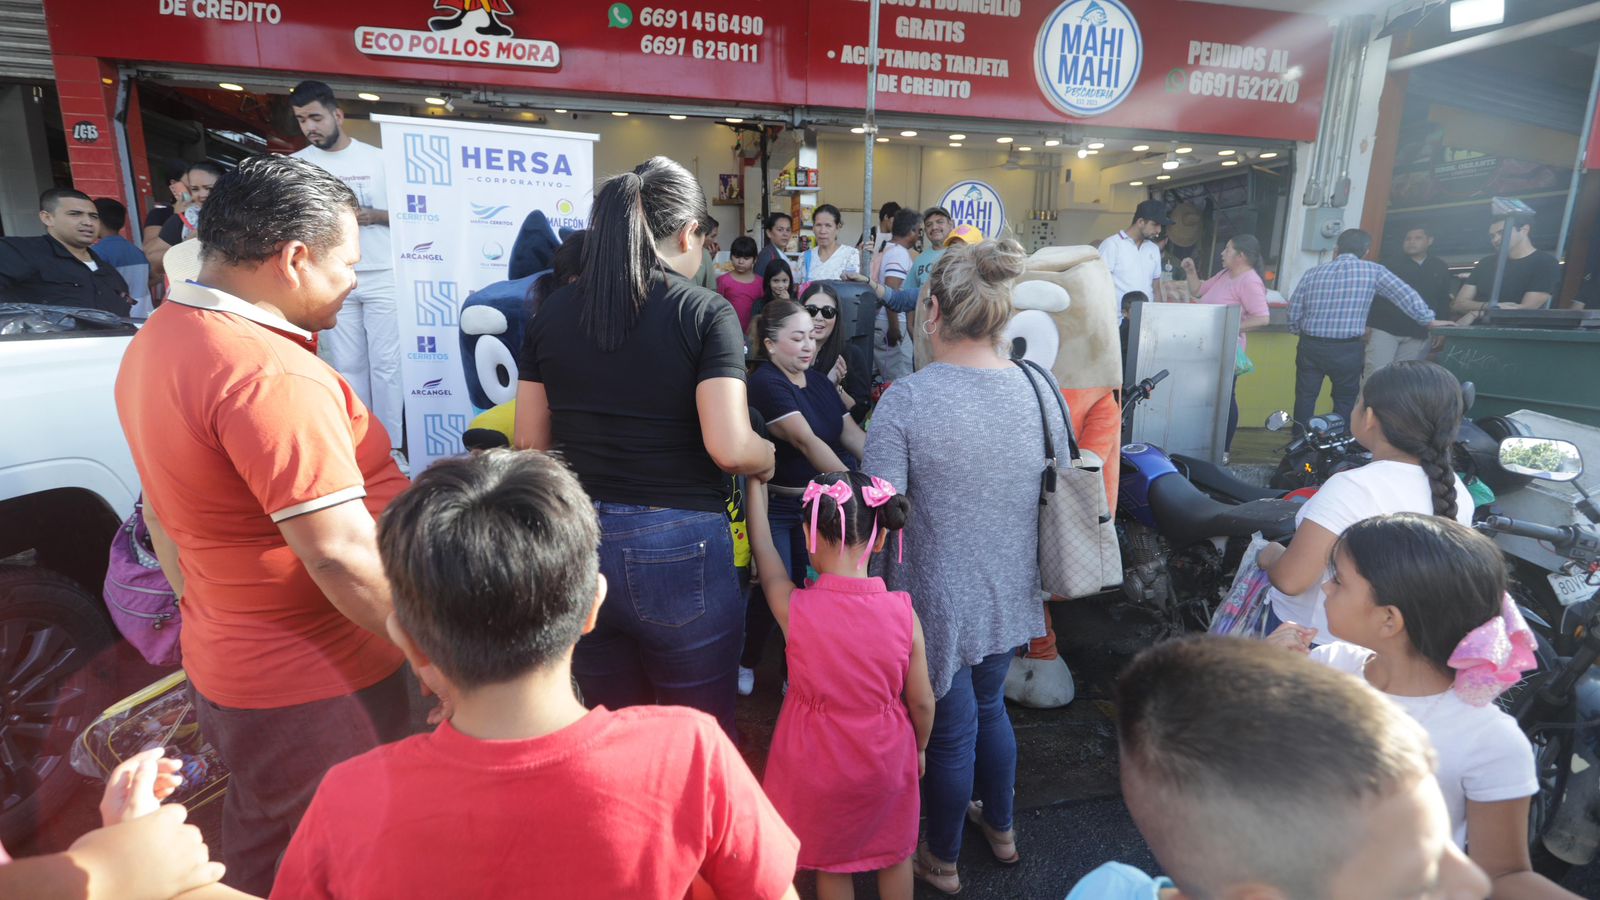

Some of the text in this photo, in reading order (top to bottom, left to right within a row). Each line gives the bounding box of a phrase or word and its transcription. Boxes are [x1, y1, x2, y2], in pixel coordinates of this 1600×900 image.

[159, 0, 281, 24] DE CREDITO
[895, 16, 965, 43] GRATIS
[1060, 23, 1124, 58] MAHI
[361, 30, 555, 62] ECO POLLOS MORA
[640, 34, 758, 63] 6691 625011
[1187, 40, 1290, 74] PEDIDOS AL
[945, 54, 1009, 77] TARJETA
[1058, 54, 1121, 88] MAHI
[877, 73, 971, 99] DE CREDITO
[1188, 70, 1300, 104] 6691 521270
[461, 145, 573, 176] HERSA
[476, 176, 562, 188] CORPORATIVO
[396, 211, 440, 222] CERRITOS
[950, 199, 993, 220] MAHI
[400, 253, 444, 262] ARCANGEL
[407, 352, 449, 361] CERRITOS
